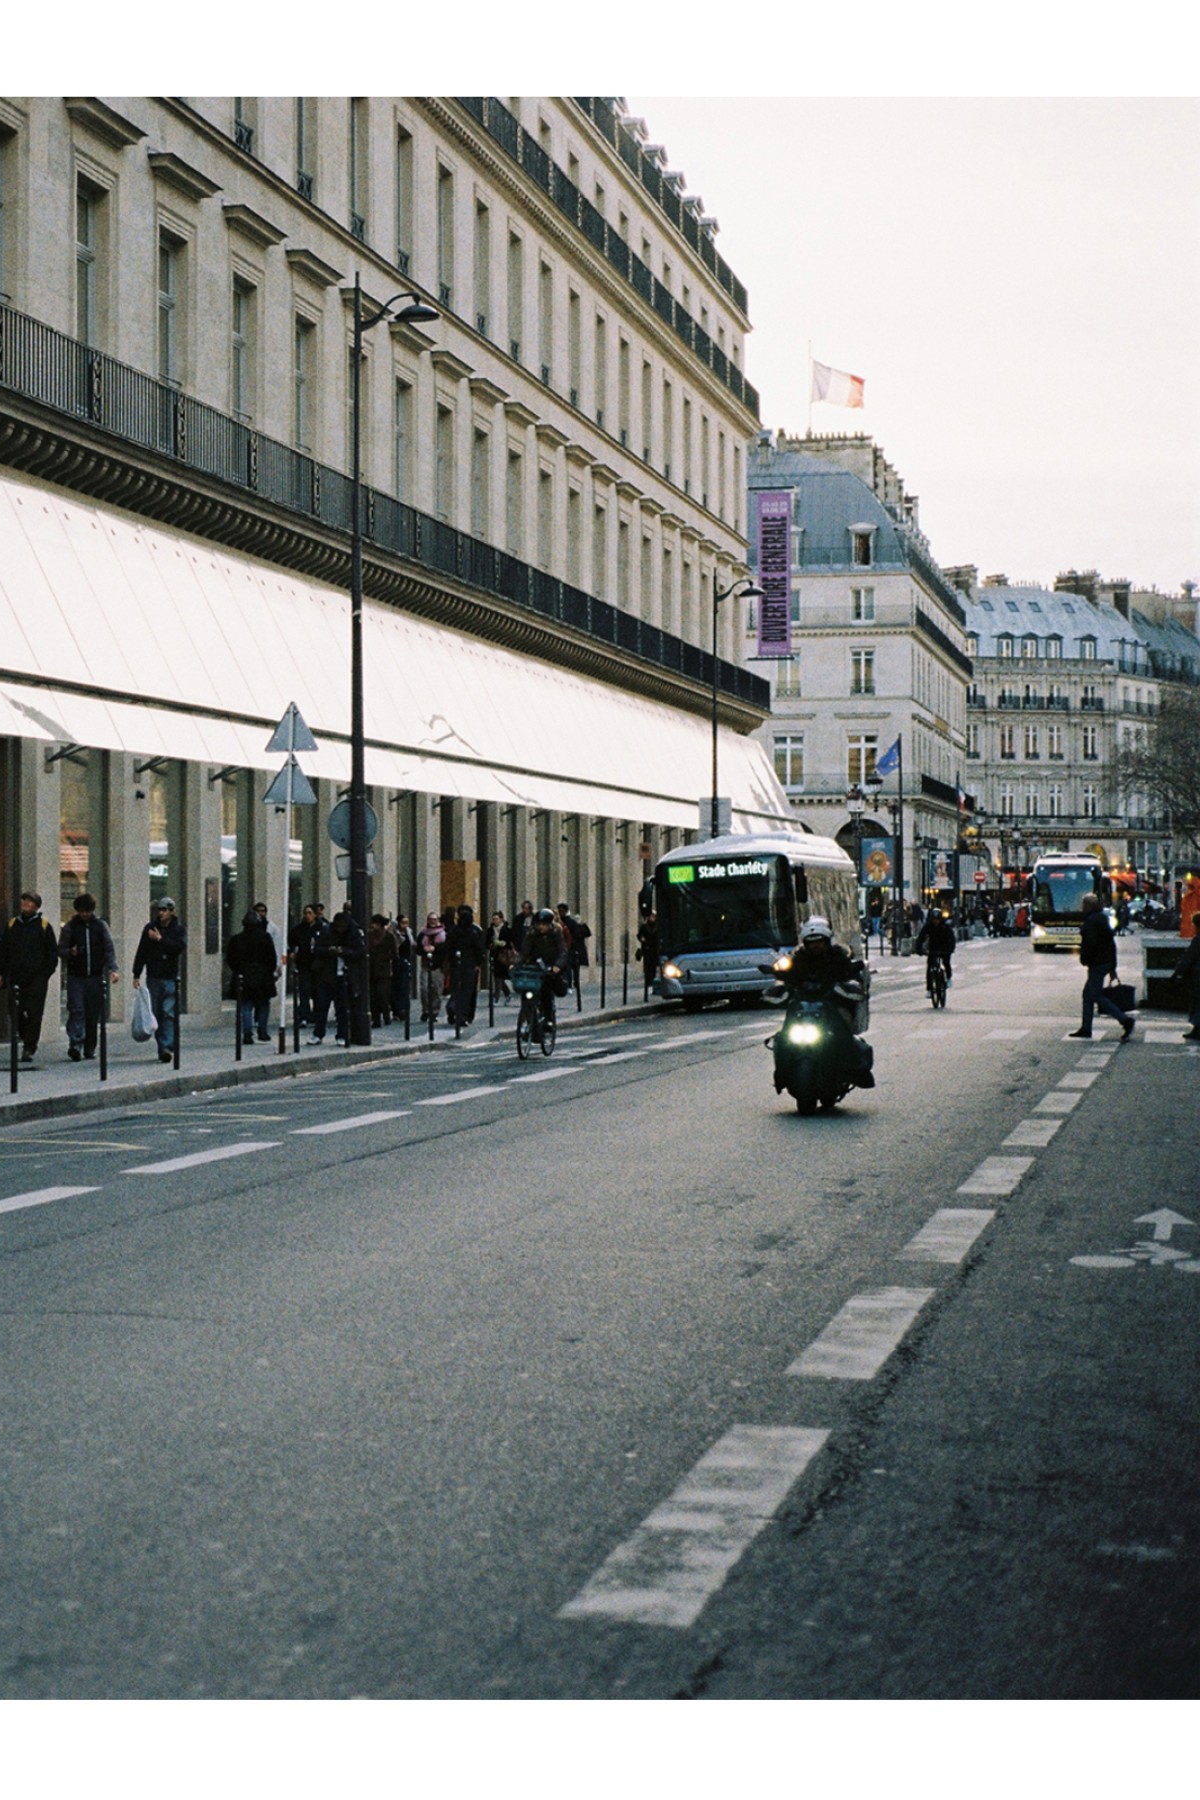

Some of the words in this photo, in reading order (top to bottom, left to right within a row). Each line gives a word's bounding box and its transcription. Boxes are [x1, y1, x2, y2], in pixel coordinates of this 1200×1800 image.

[761, 576, 787, 643] OUVERTURE
[698, 864, 727, 878] Stade
[728, 861, 769, 877] Charléty
